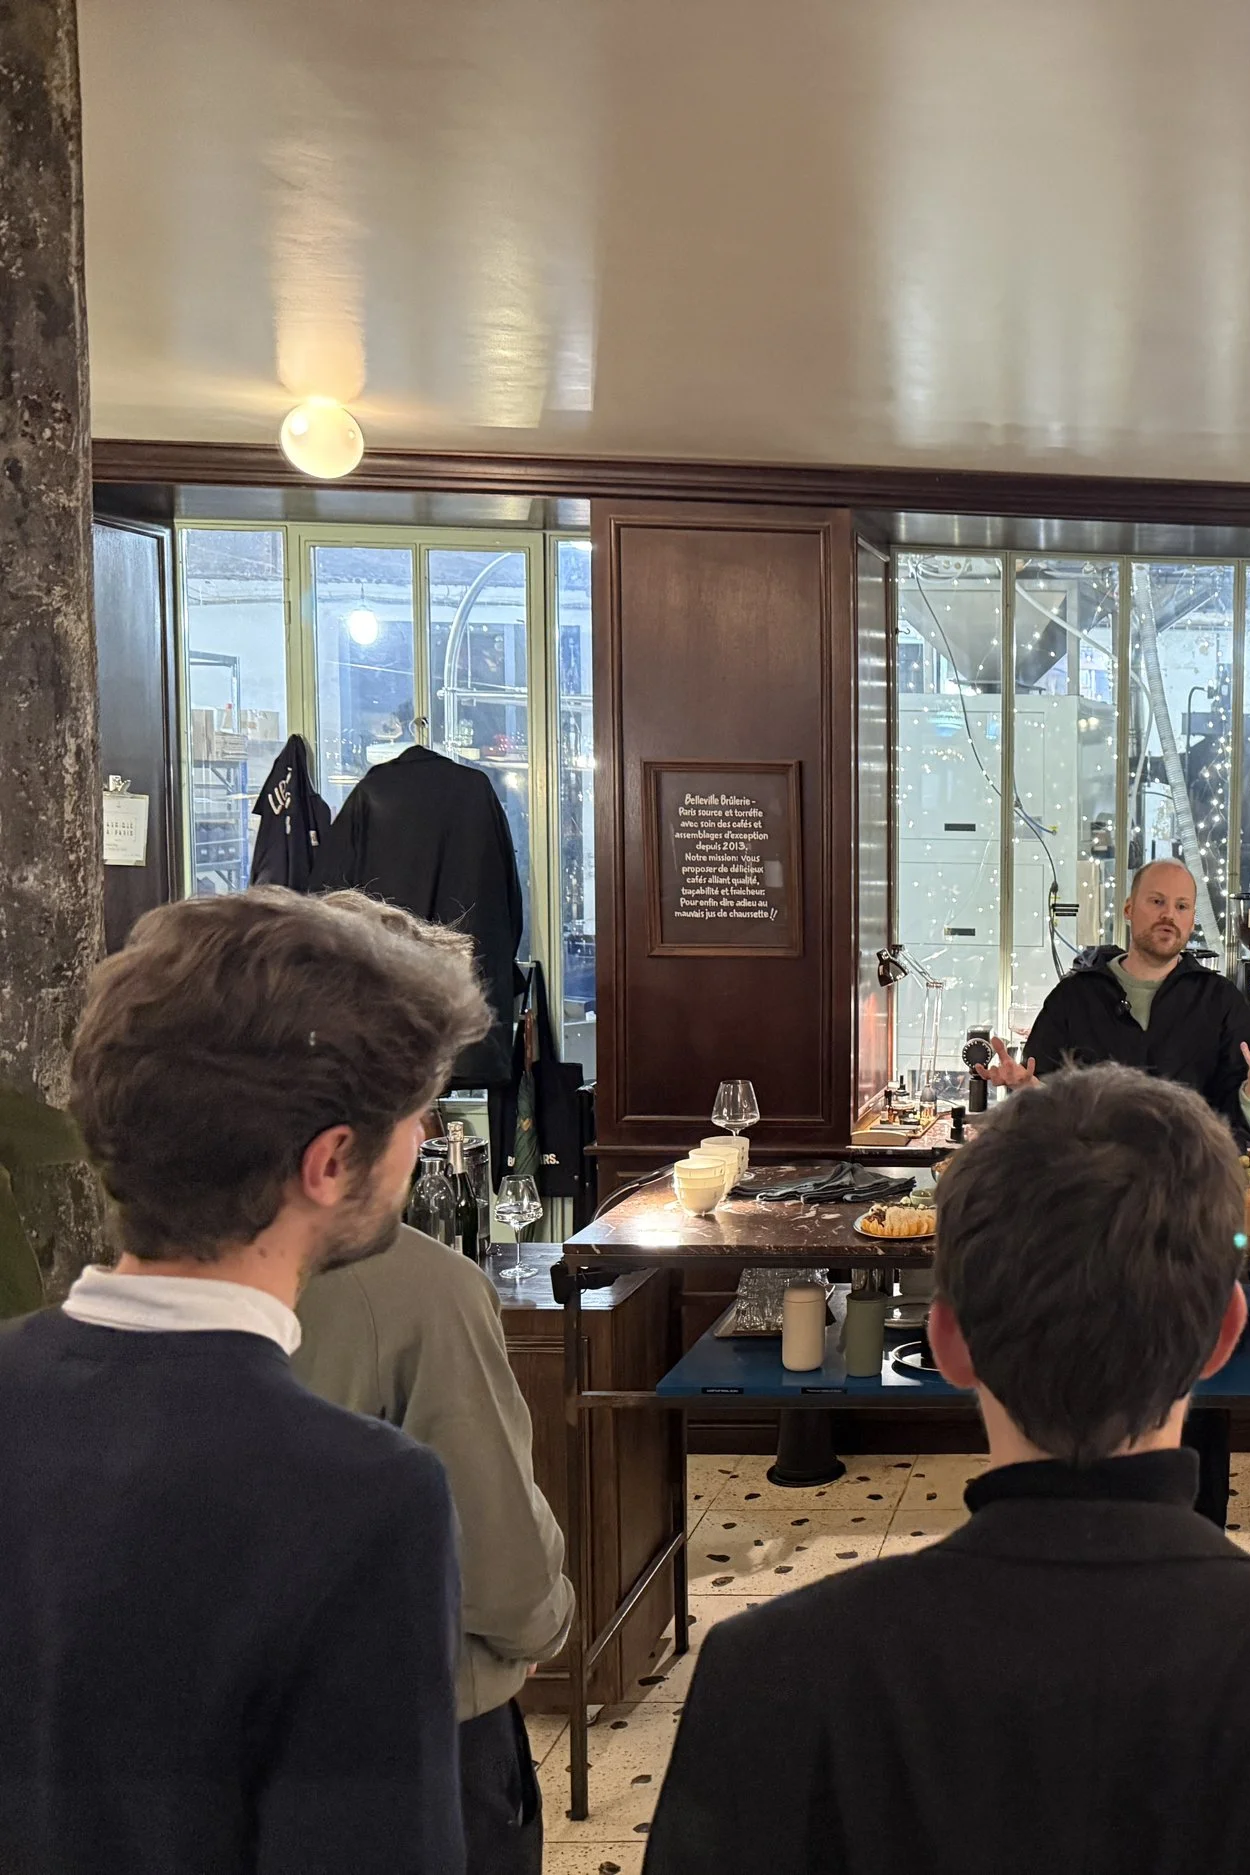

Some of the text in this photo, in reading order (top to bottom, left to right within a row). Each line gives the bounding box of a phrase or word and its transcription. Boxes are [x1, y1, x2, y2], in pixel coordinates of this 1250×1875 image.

[684, 793, 720, 806] Belleville
[678, 806, 697, 816] Paris
[698, 808, 723, 817] source
[724, 808, 734, 817] et
[680, 819, 762, 828] avec soin des cafés et
[674, 830, 723, 841] assemblages
[695, 841, 721, 852] depuis
[685, 853, 708, 862] Notre
[681, 864, 764, 875] proposer de délicieux
[686, 875, 707, 884] cafés
[707, 875, 731, 884] alliant
[720, 887, 730, 895] et
[680, 897, 700, 907] Pour
[699, 897, 719, 907] enfin
[719, 898, 735, 907] dire
[735, 898, 757, 907] adieu
[674, 909, 705, 918] mauvais
[705, 908, 716, 920] jus
[717, 908, 728, 918] de
[728, 909, 769, 918] chaussette
